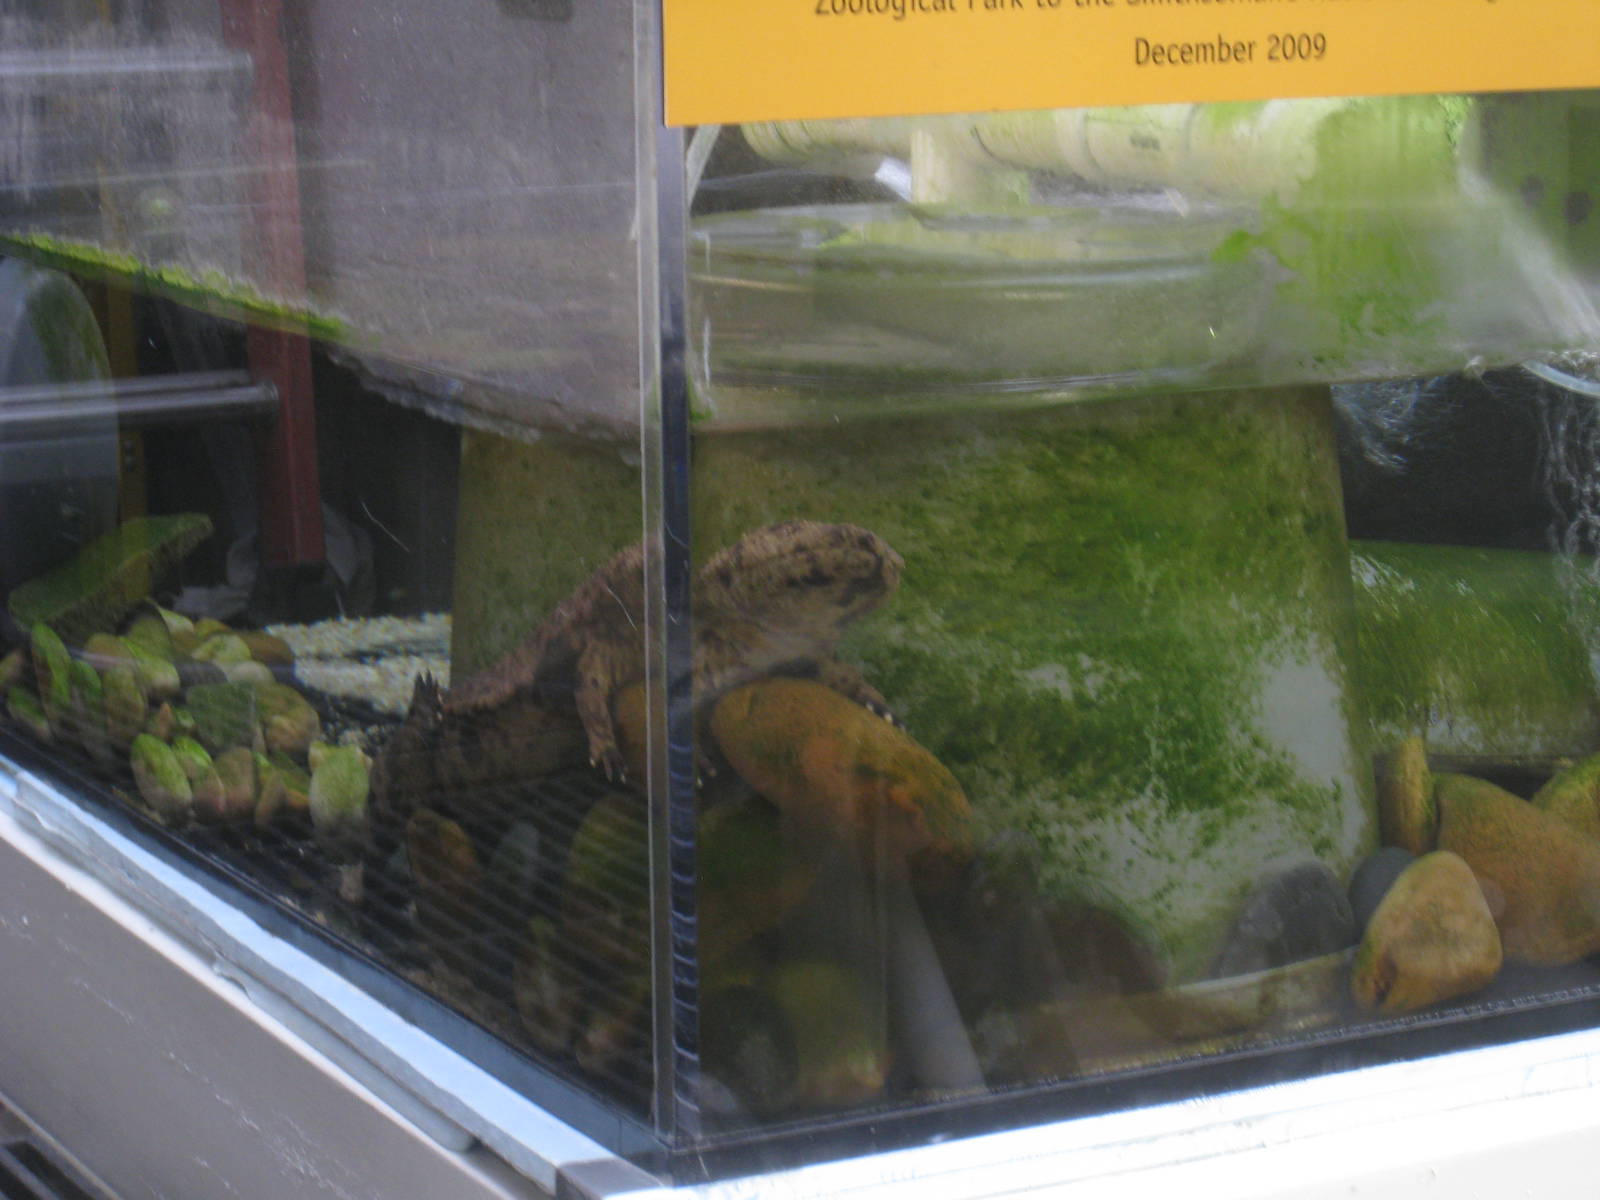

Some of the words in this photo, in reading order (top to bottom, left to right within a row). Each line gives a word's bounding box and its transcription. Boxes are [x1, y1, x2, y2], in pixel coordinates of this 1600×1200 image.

[968, 0, 1023, 9] ar
[1134, 33, 1254, 65] December
[1267, 33, 1326, 62] 2009
